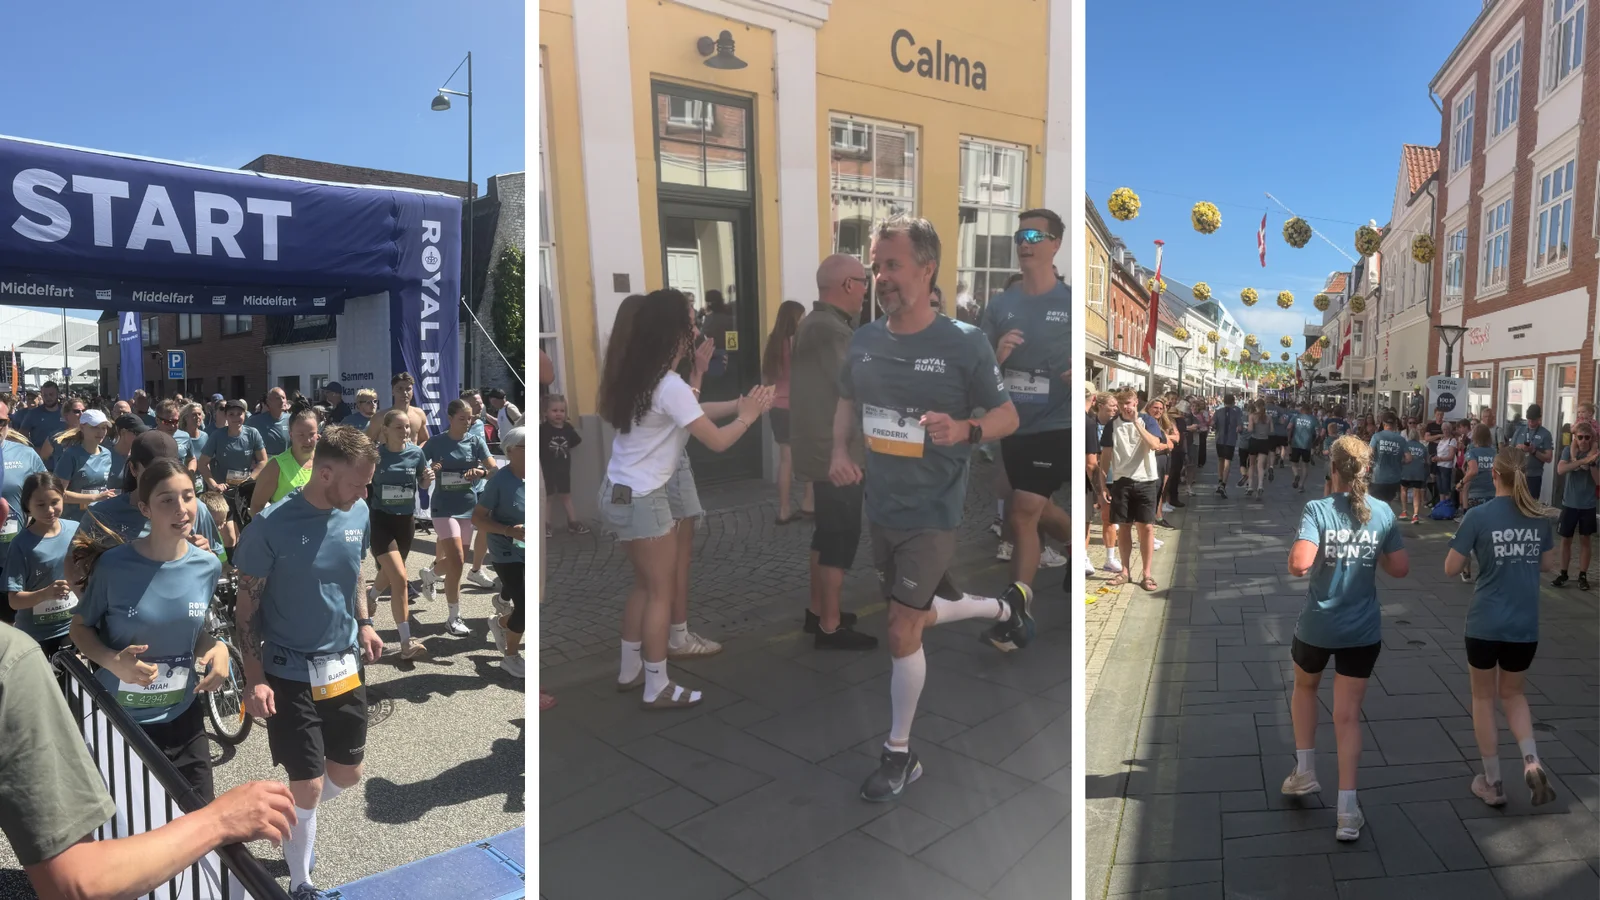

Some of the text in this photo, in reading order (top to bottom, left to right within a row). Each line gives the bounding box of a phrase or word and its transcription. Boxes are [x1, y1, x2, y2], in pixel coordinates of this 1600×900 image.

[891, 28, 987, 91] Calma
[11, 168, 292, 261] START
[0, 282, 74, 298] Middelfart
[132, 291, 194, 303] Middelfart
[243, 295, 297, 306] Middelfart
[421, 219, 442, 426] ROYAL RUN
[171, 353, 181, 367] P
[914, 357, 946, 366] ROYAL
[914, 364, 934, 372] RUN
[341, 371, 374, 381] Sammen
[872, 427, 908, 439] FREDERIK
[1380, 439, 1400, 448] ROYAL
[1325, 528, 1379, 545] ROYAL
[1491, 528, 1541, 544] ROYAL
[45, 602, 72, 613] ISABELLA
[327, 669, 348, 681] BJARNE
[143, 683, 169, 691] ARIAH
[320, 687, 327, 695] B
[126, 693, 168, 703] C 42947
